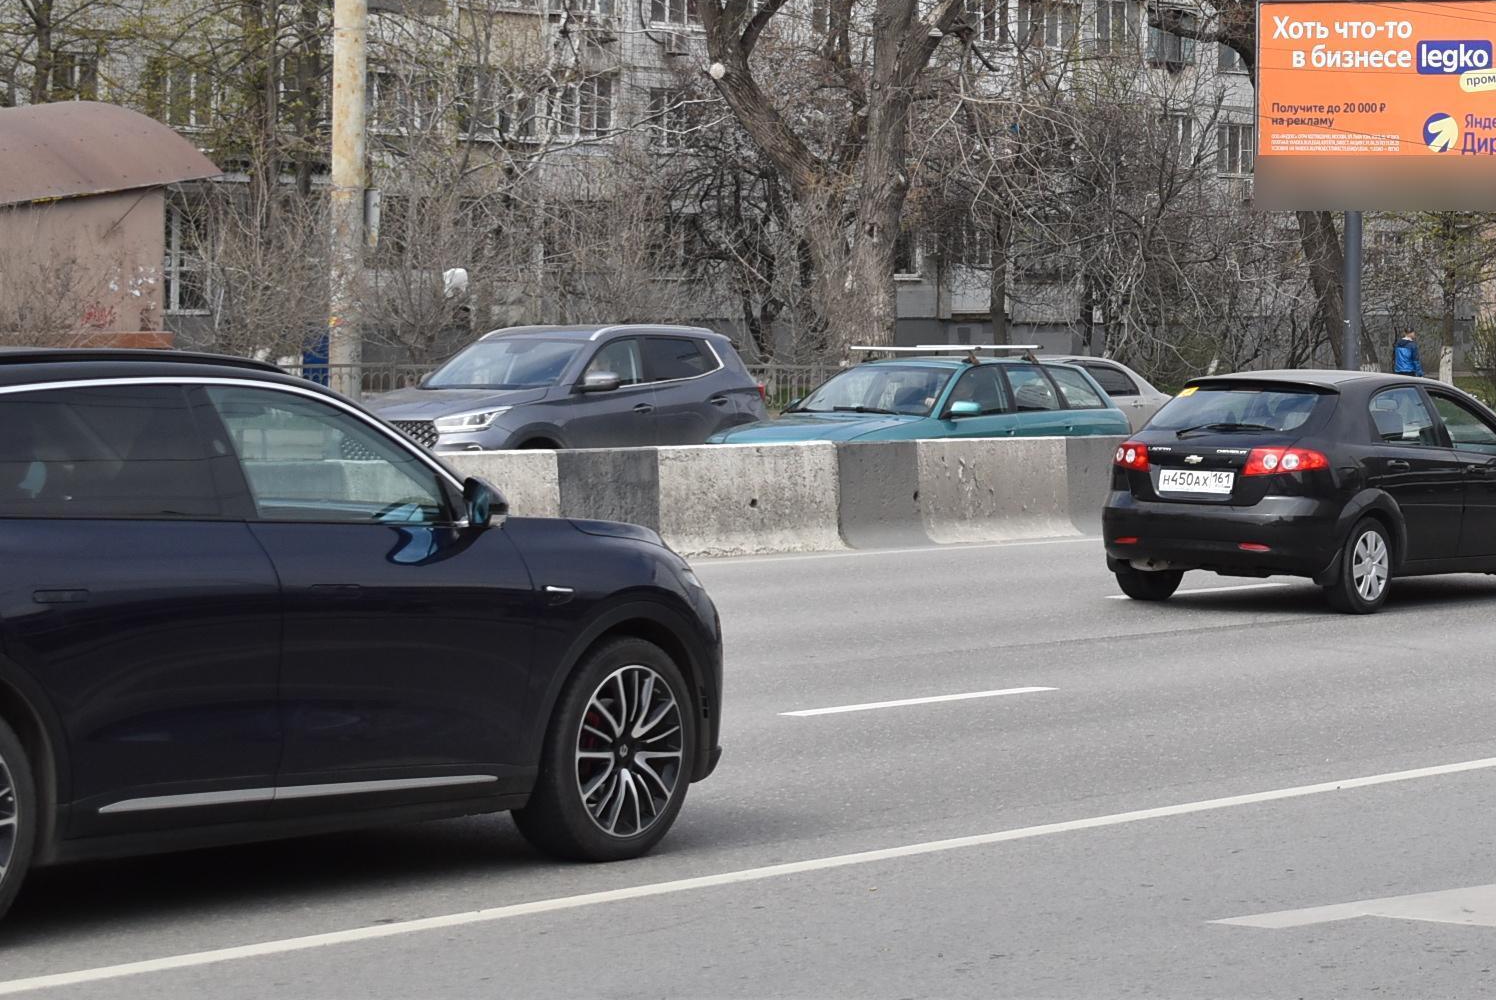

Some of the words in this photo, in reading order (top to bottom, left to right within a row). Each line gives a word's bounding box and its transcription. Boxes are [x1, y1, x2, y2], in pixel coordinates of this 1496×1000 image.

[1272, 16, 1329, 39] Хоть
[1335, 20, 1412, 39] что-то
[1292, 50, 1305, 67] в
[1311, 45, 1412, 68] бизнесе
[1421, 43, 1489, 72] legko
[1272, 102, 1325, 115] Получите
[1327, 104, 1341, 114] до
[1343, 103, 1356, 113] 20
[1358, 103, 1377, 113] 000
[1272, 117, 1284, 126] на
[1286, 116, 1334, 128] рекламу
[1212, 472, 1231, 484] 161
